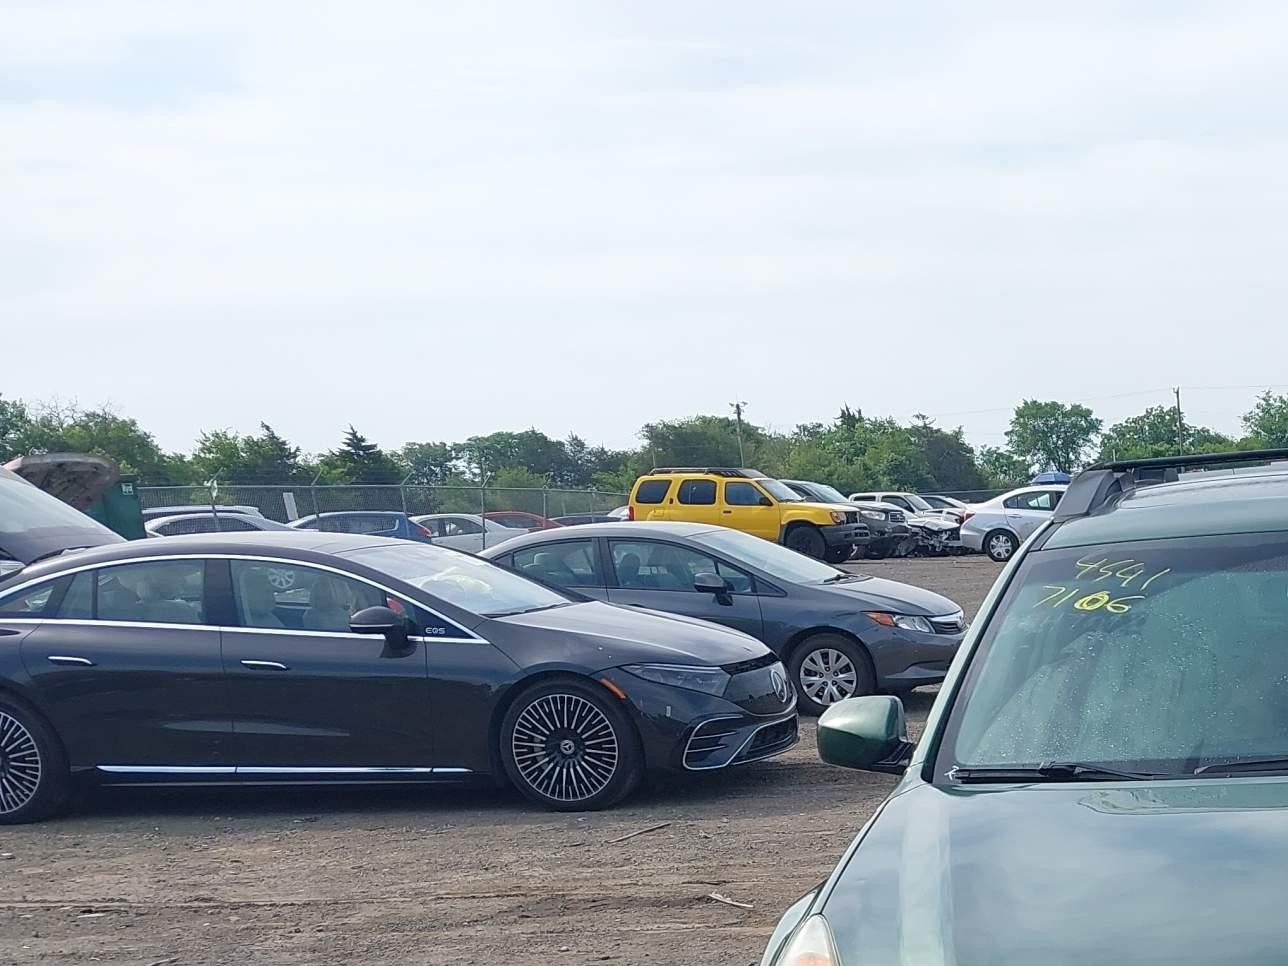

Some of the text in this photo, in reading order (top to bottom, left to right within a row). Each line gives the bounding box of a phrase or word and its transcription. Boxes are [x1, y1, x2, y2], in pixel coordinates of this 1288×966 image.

[1075, 558, 1170, 591] 4541
[1032, 585, 1146, 613] 7106
[425, 627, 446, 635] EQS
